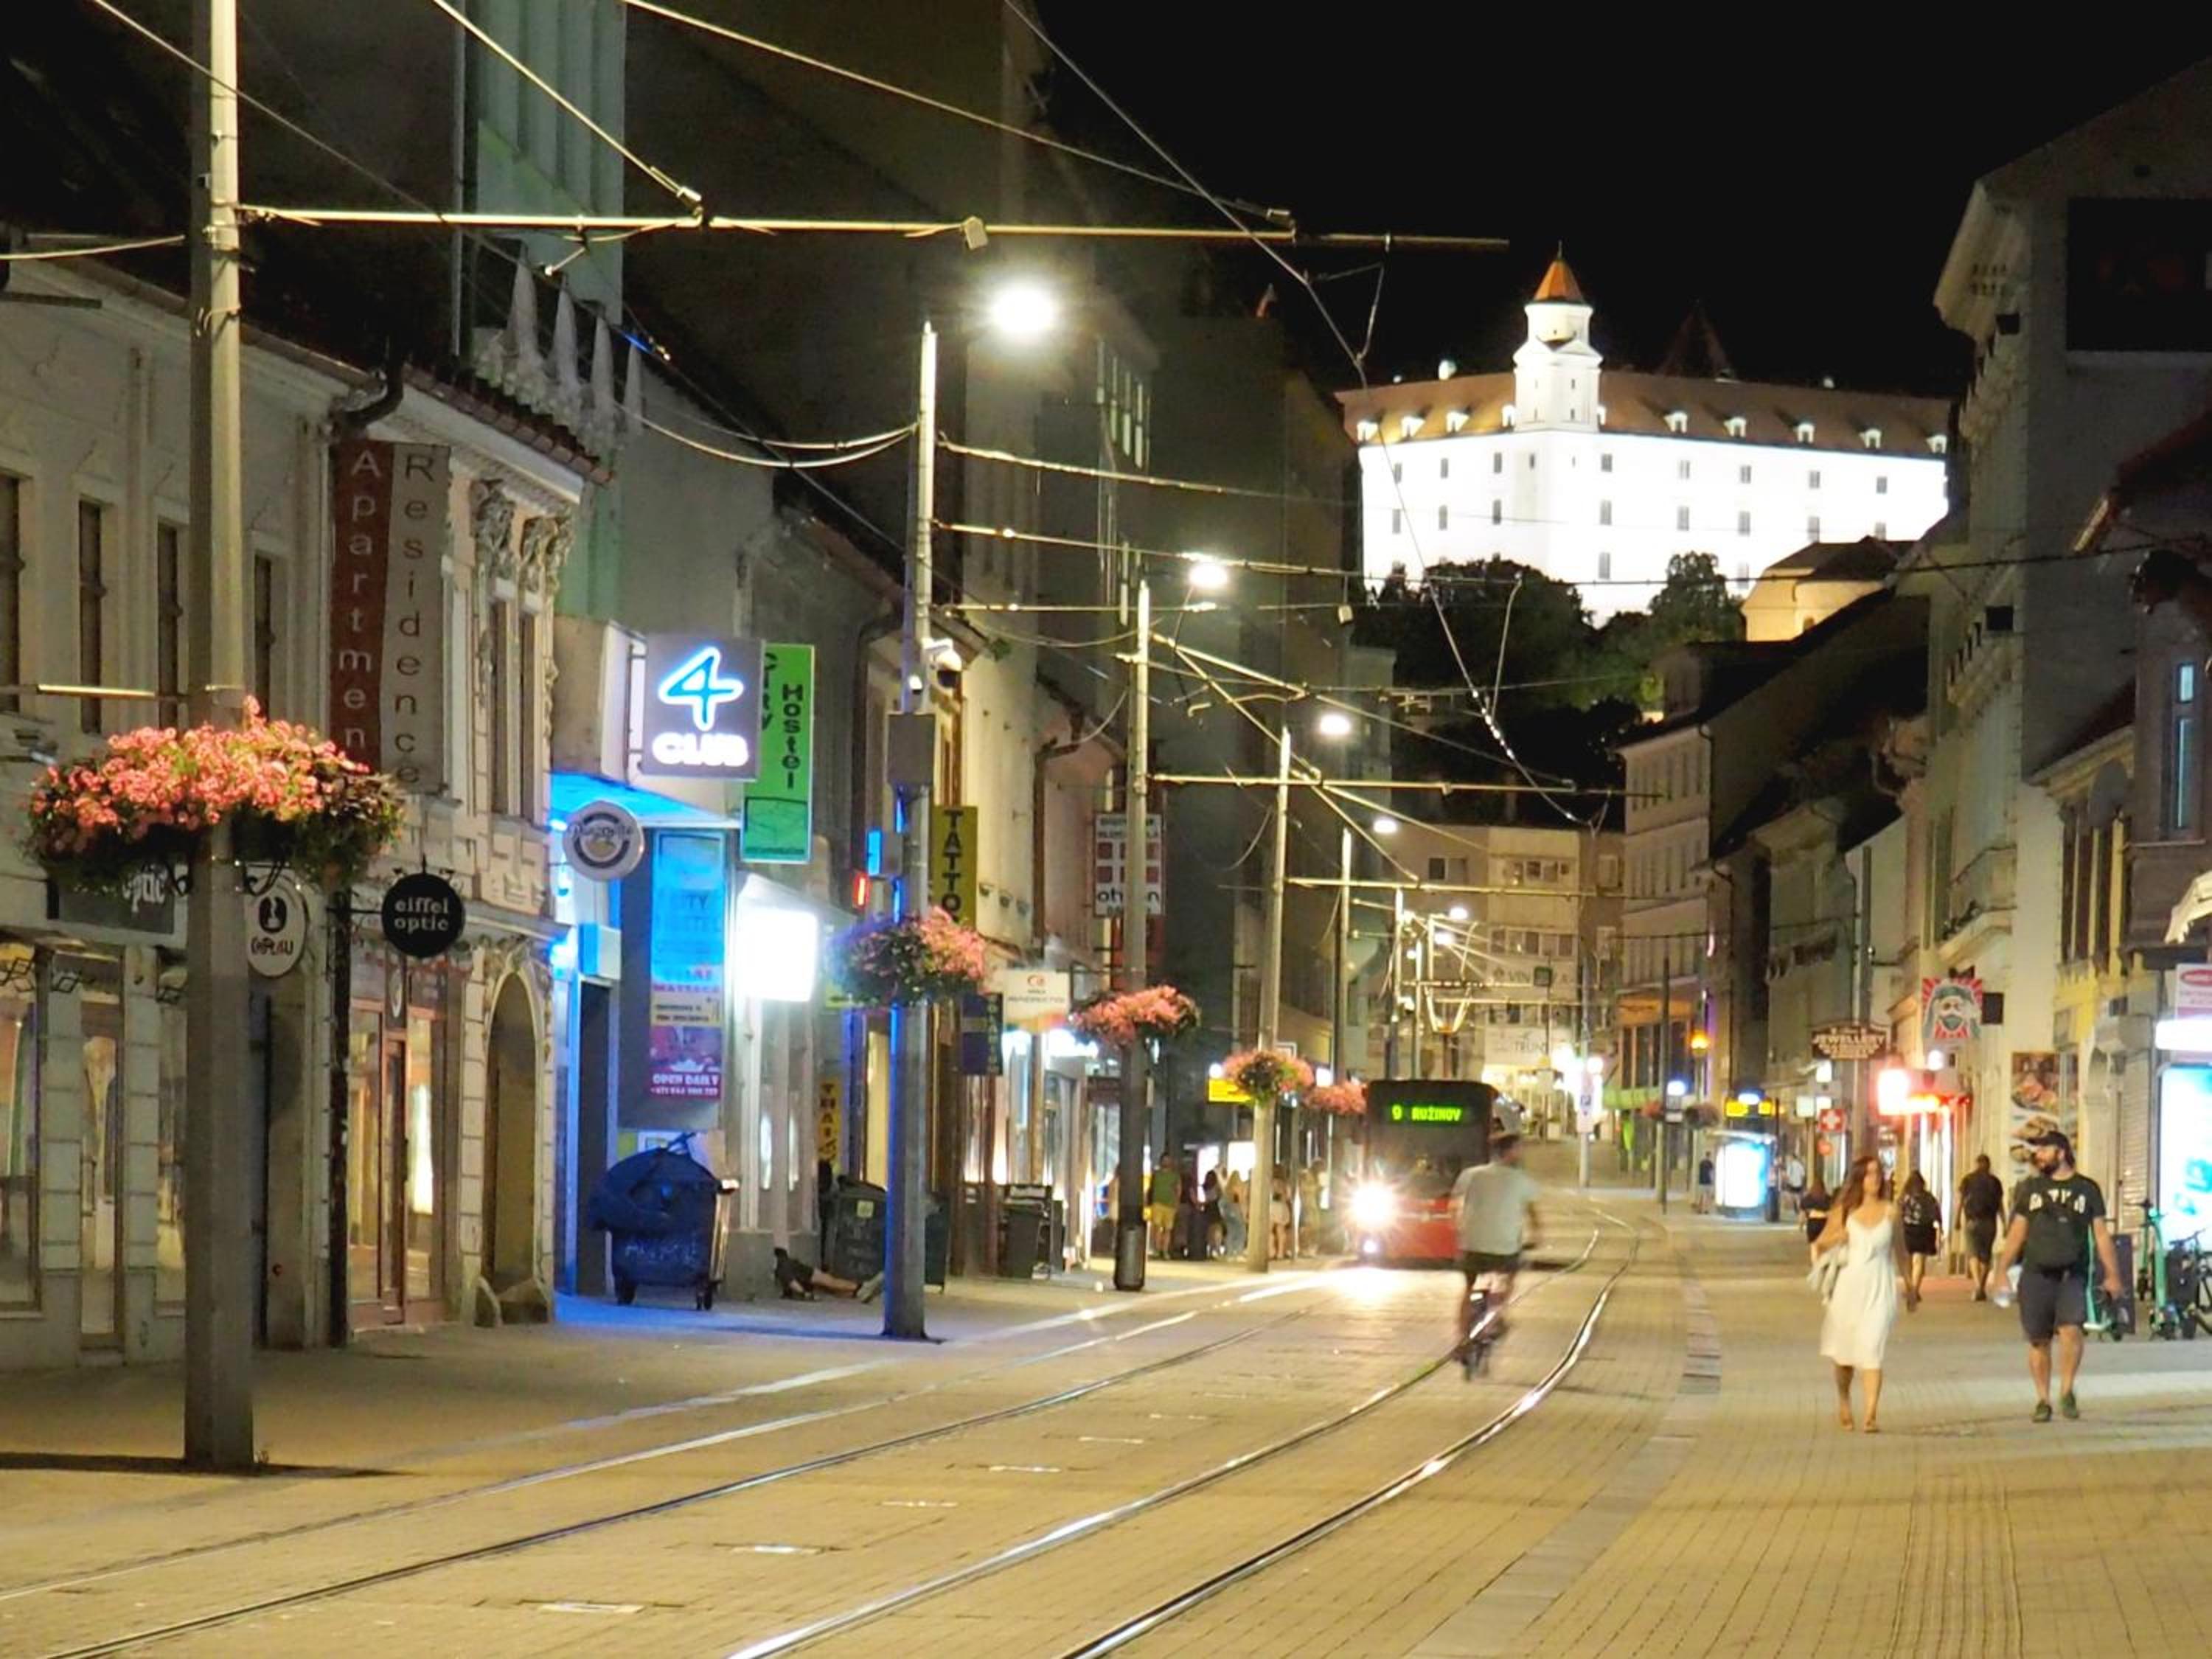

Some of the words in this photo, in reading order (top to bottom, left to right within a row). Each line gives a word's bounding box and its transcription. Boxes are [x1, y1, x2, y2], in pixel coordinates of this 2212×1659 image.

[338, 452, 380, 748] Apartmen
[394, 453, 435, 785] Residence
[658, 645, 744, 732] 4
[782, 684, 803, 789] Hostel
[395, 897, 448, 914] eiffel
[942, 809, 964, 924] TATTO
[394, 915, 448, 933] optic
[653, 1074, 683, 1085] OPEN
[685, 1074, 719, 1085] DAILY
[1391, 1105, 1402, 1120] 9
